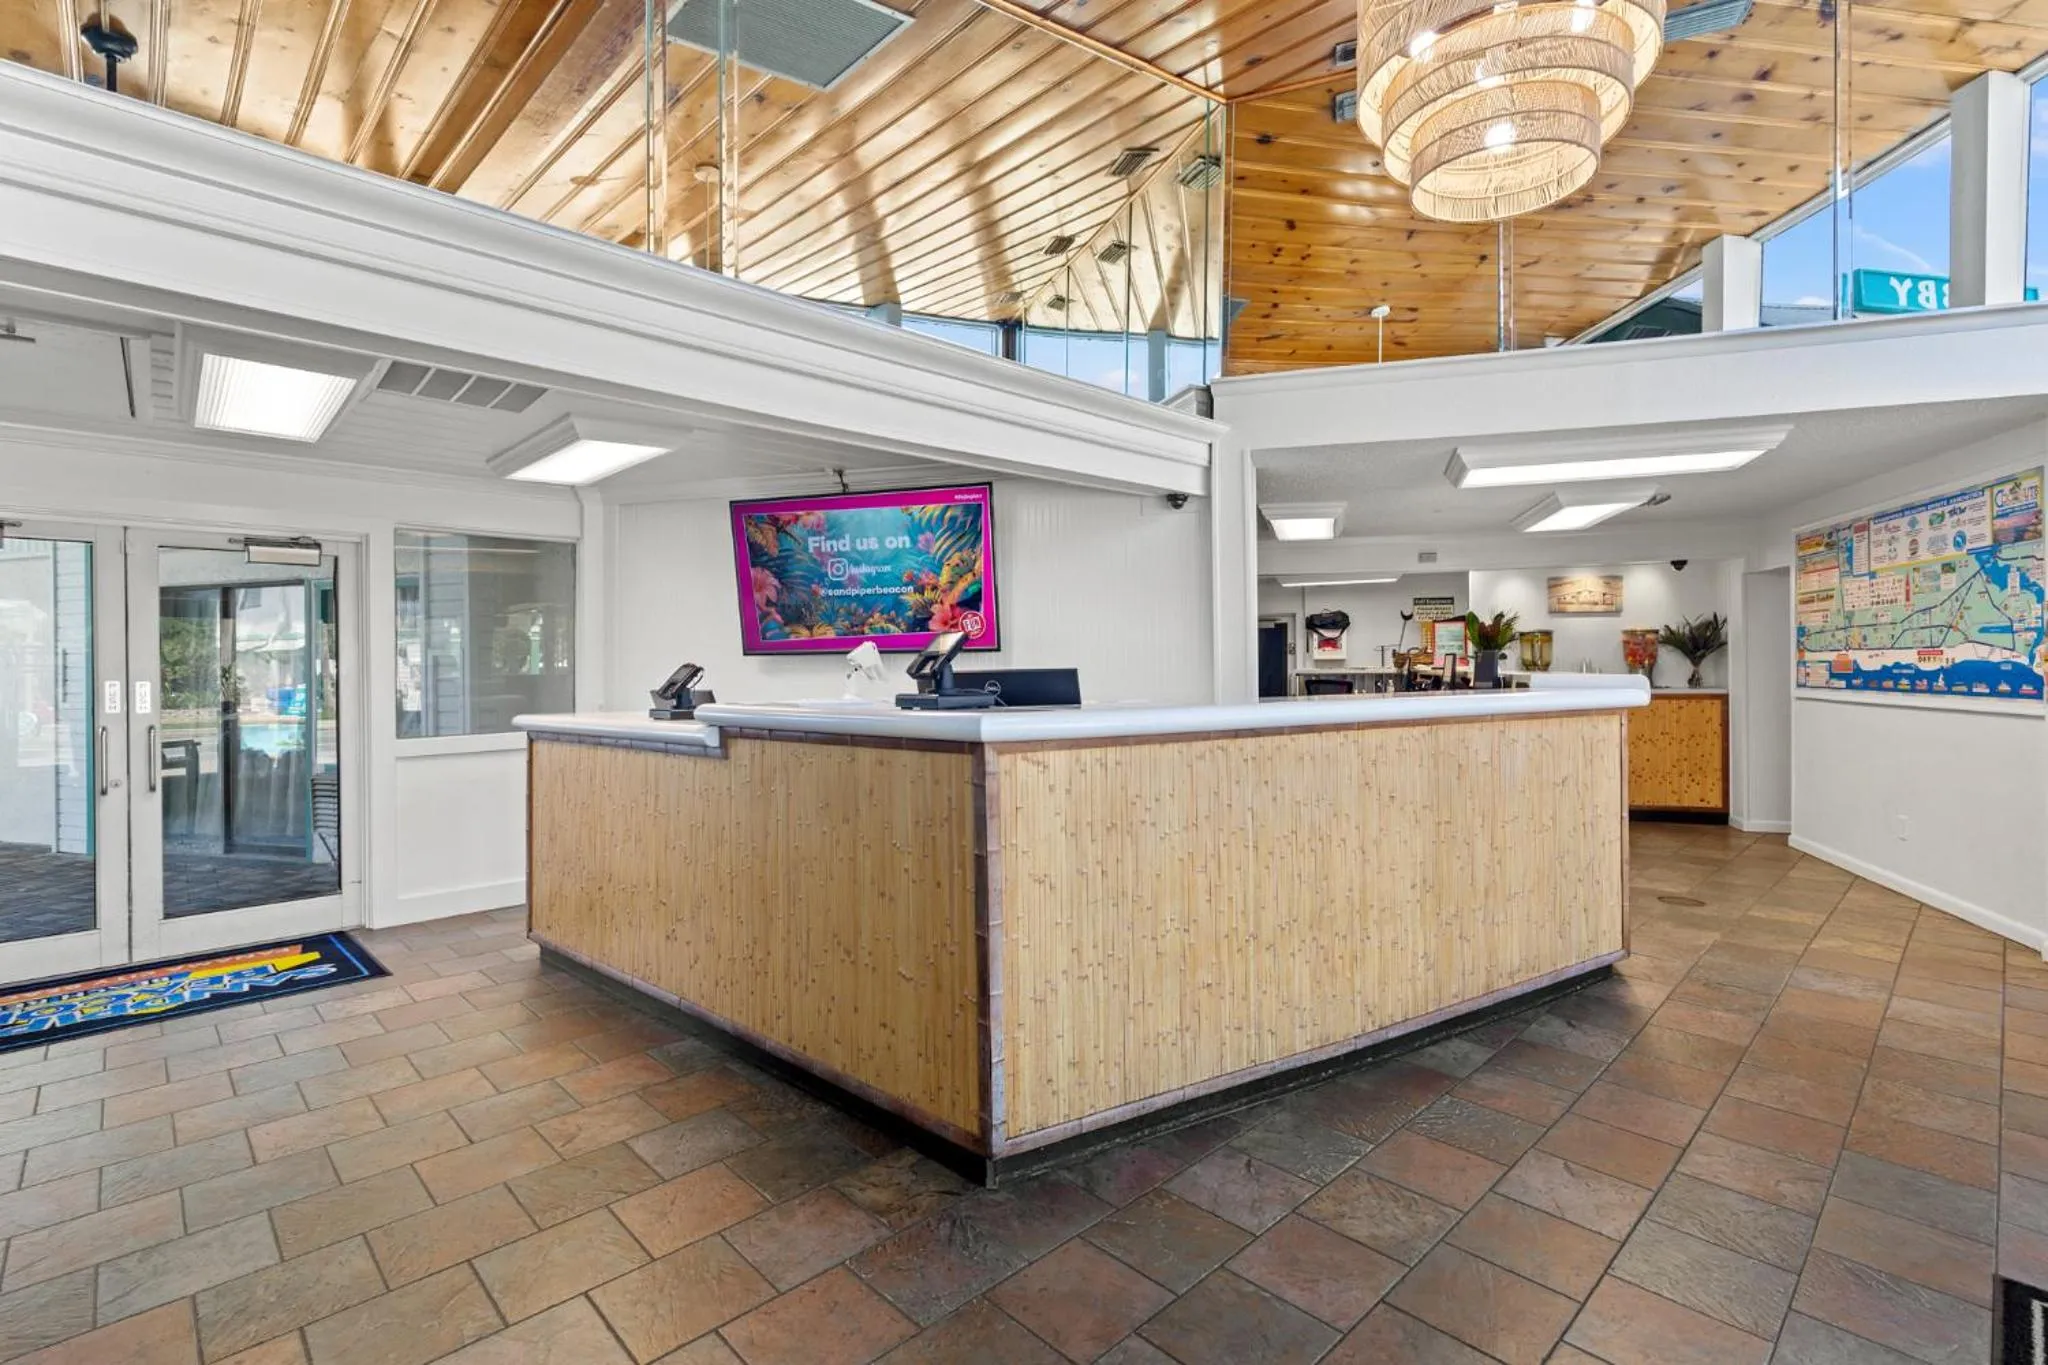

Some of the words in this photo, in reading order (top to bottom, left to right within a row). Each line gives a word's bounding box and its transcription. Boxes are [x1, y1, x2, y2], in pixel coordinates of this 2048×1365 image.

[807, 534, 850, 553] Find
[855, 537, 879, 550] us
[885, 535, 911, 549] on
